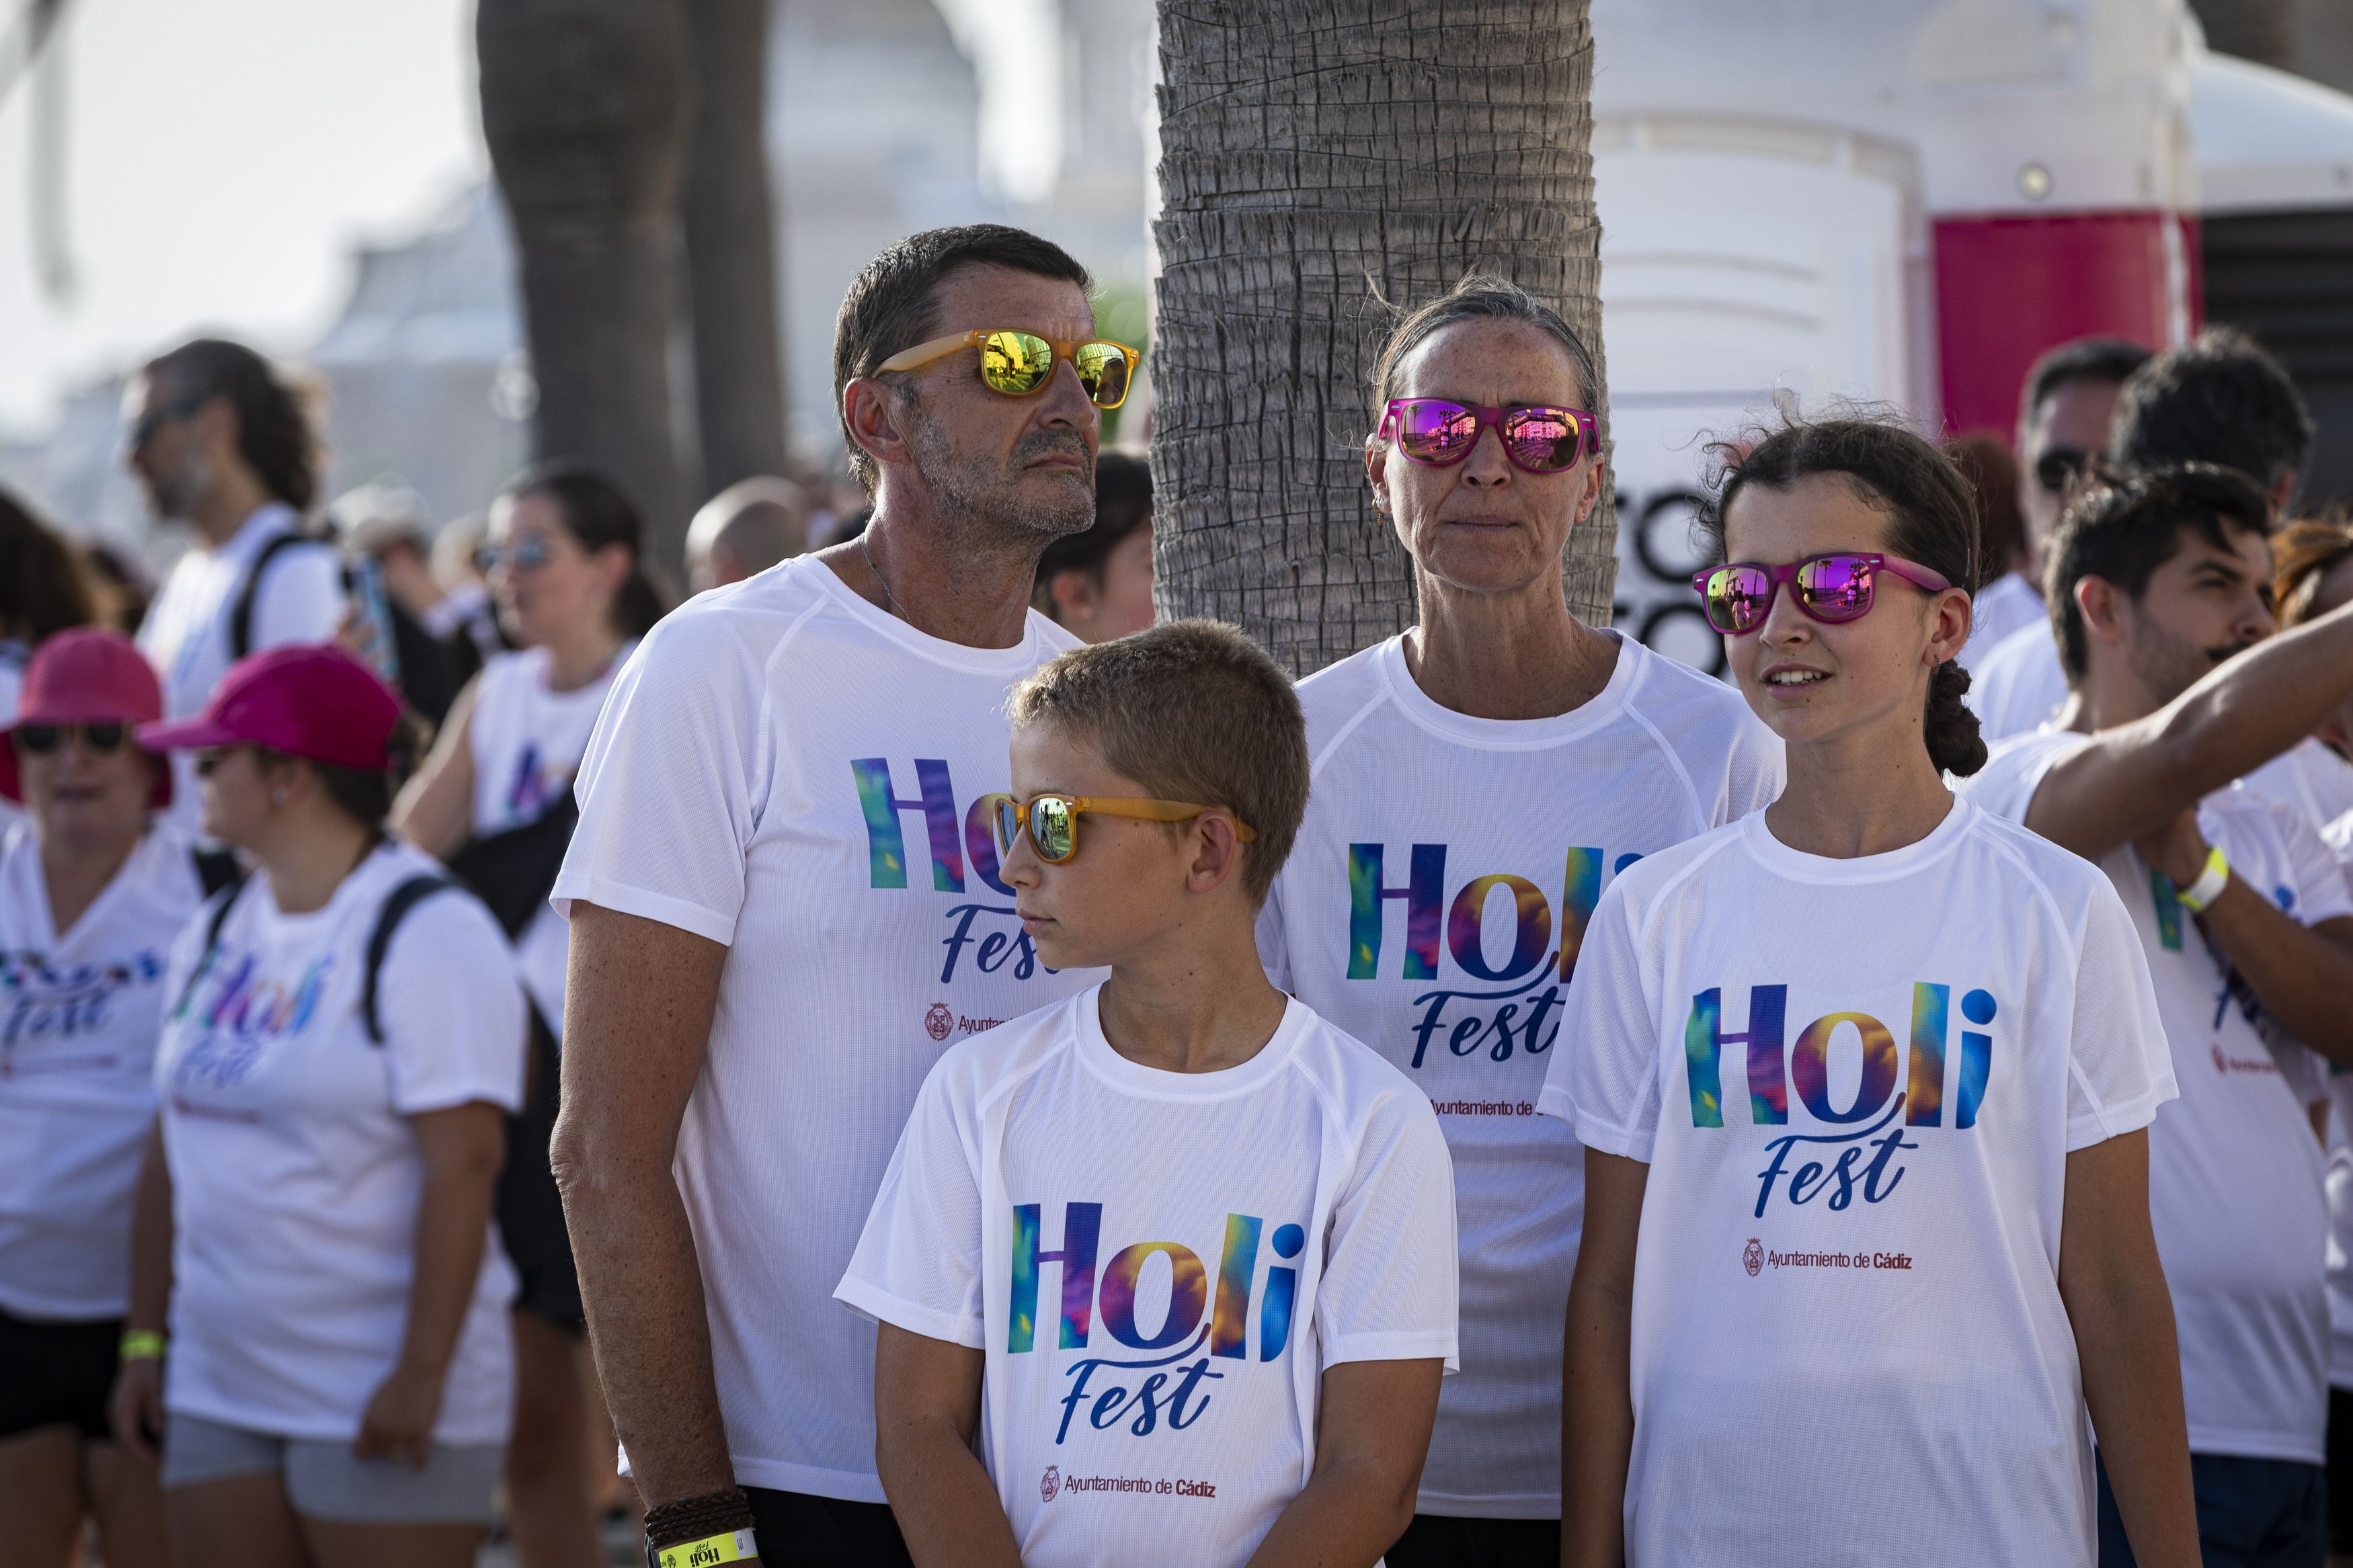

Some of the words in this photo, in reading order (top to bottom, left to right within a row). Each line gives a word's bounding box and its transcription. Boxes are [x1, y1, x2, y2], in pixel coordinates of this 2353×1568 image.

[850, 757, 1016, 897] Ho
[941, 904, 1060, 984] Fes
[1347, 843, 1645, 984] Hol
[1411, 984, 1566, 1069] Fest
[1684, 981, 1997, 1130] Holi
[1516, 1100, 1533, 1116] de
[1754, 1128, 1919, 1219] Fest
[1007, 1202, 1305, 1362] Holi
[1767, 1250, 1850, 1269] Ayuntamiento
[1853, 1252, 1870, 1268] de
[1874, 1252, 1912, 1270] Cádiz
[1055, 1358, 1224, 1444] Fest
[1064, 1475, 1152, 1494] Ayuntamiento
[1155, 1478, 1172, 1494] de
[1176, 1479, 1216, 1498] Cádiz
[689, 1548, 720, 1567] Holi
[694, 1541, 709, 1553] Fest
